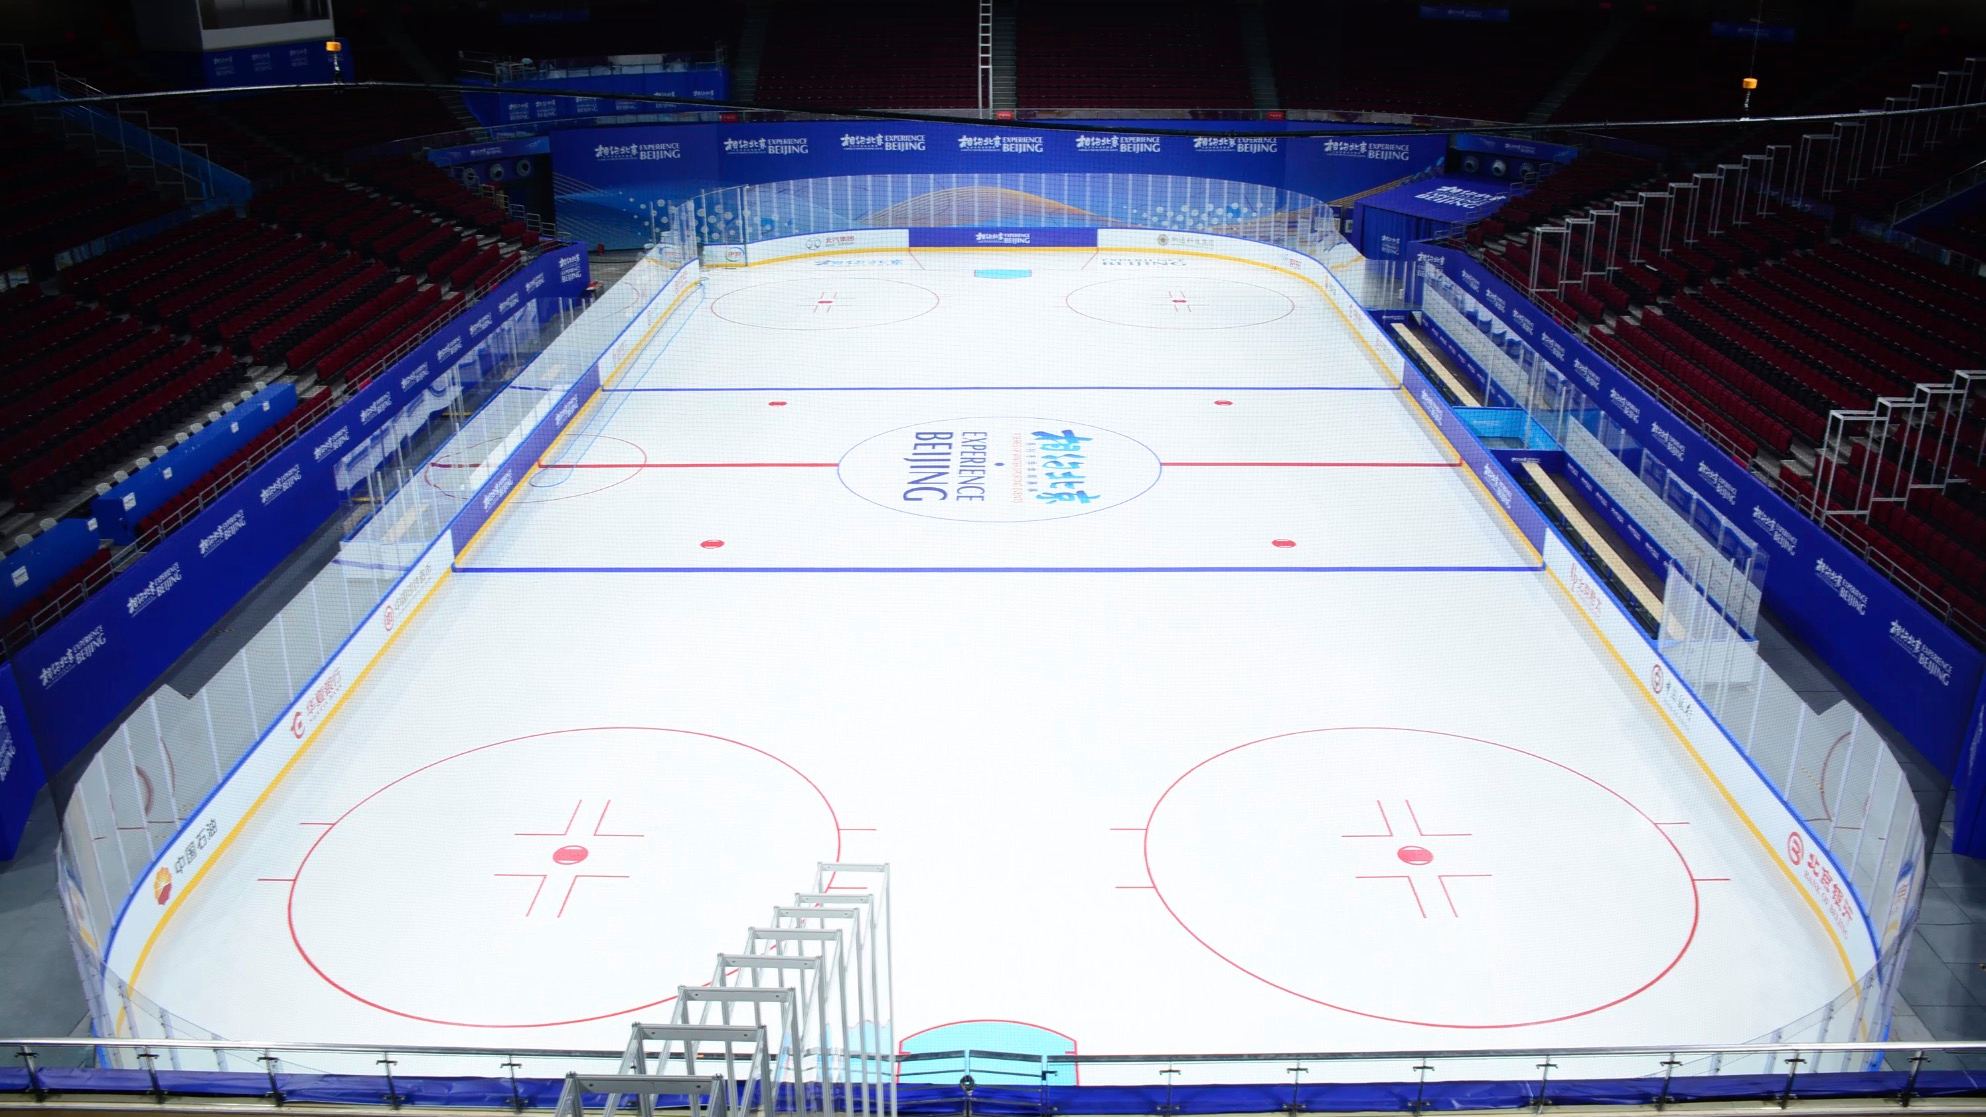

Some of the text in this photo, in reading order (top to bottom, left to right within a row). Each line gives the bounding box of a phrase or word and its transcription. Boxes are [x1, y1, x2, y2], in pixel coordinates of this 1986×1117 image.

[724, 138, 767, 151] 相约北京
[840, 134, 884, 147] 相约北京
[884, 134, 926, 142] EXPERIENCE
[958, 135, 1002, 148] 相约北京
[1075, 135, 1120, 148] 相约北京
[1120, 136, 1160, 144] EXPERIENCE
[1192, 136, 1236, 149] 相约北京
[594, 144, 638, 158] 相约北京
[639, 142, 680, 150] EXPERIENCE
[768, 144, 808, 155] BEIJING
[884, 142, 926, 152] BEIJING
[1002, 143, 1043, 153] BEIJING
[1120, 143, 1160, 153] BEIJING
[1237, 143, 1278, 153] BEIJING
[1324, 139, 1368, 154] 相约北京
[1368, 142, 1410, 152] EXPERIENCE
[639, 150, 681, 160] BEIJING
[1368, 150, 1410, 161] BEIJING
[1414, 194, 1480, 208] BEIJING
[562, 272, 582, 282] BEIJING
[903, 432, 954, 502] BEIJING
[956, 432, 988, 502] EXPERIENCE
[1030, 430, 1101, 504] 相约北京
[1774, 532, 1796, 556] BEIJING
[154, 562, 180, 586] EXPERIENCE
[156, 568, 182, 597] BEIJING
[1842, 579, 1869, 604] EXPERIENCE
[1839, 586, 1866, 616] BEIJING
[72, 624, 104, 653] EXPERIENCE
[74, 633, 106, 664] BEIJING
[1921, 638, 1953, 673] EXPERIENCE
[1918, 650, 1951, 686] BEIJING
[174, 818, 218, 874] 中国石油
[1807, 853, 1853, 921] 北京银行
